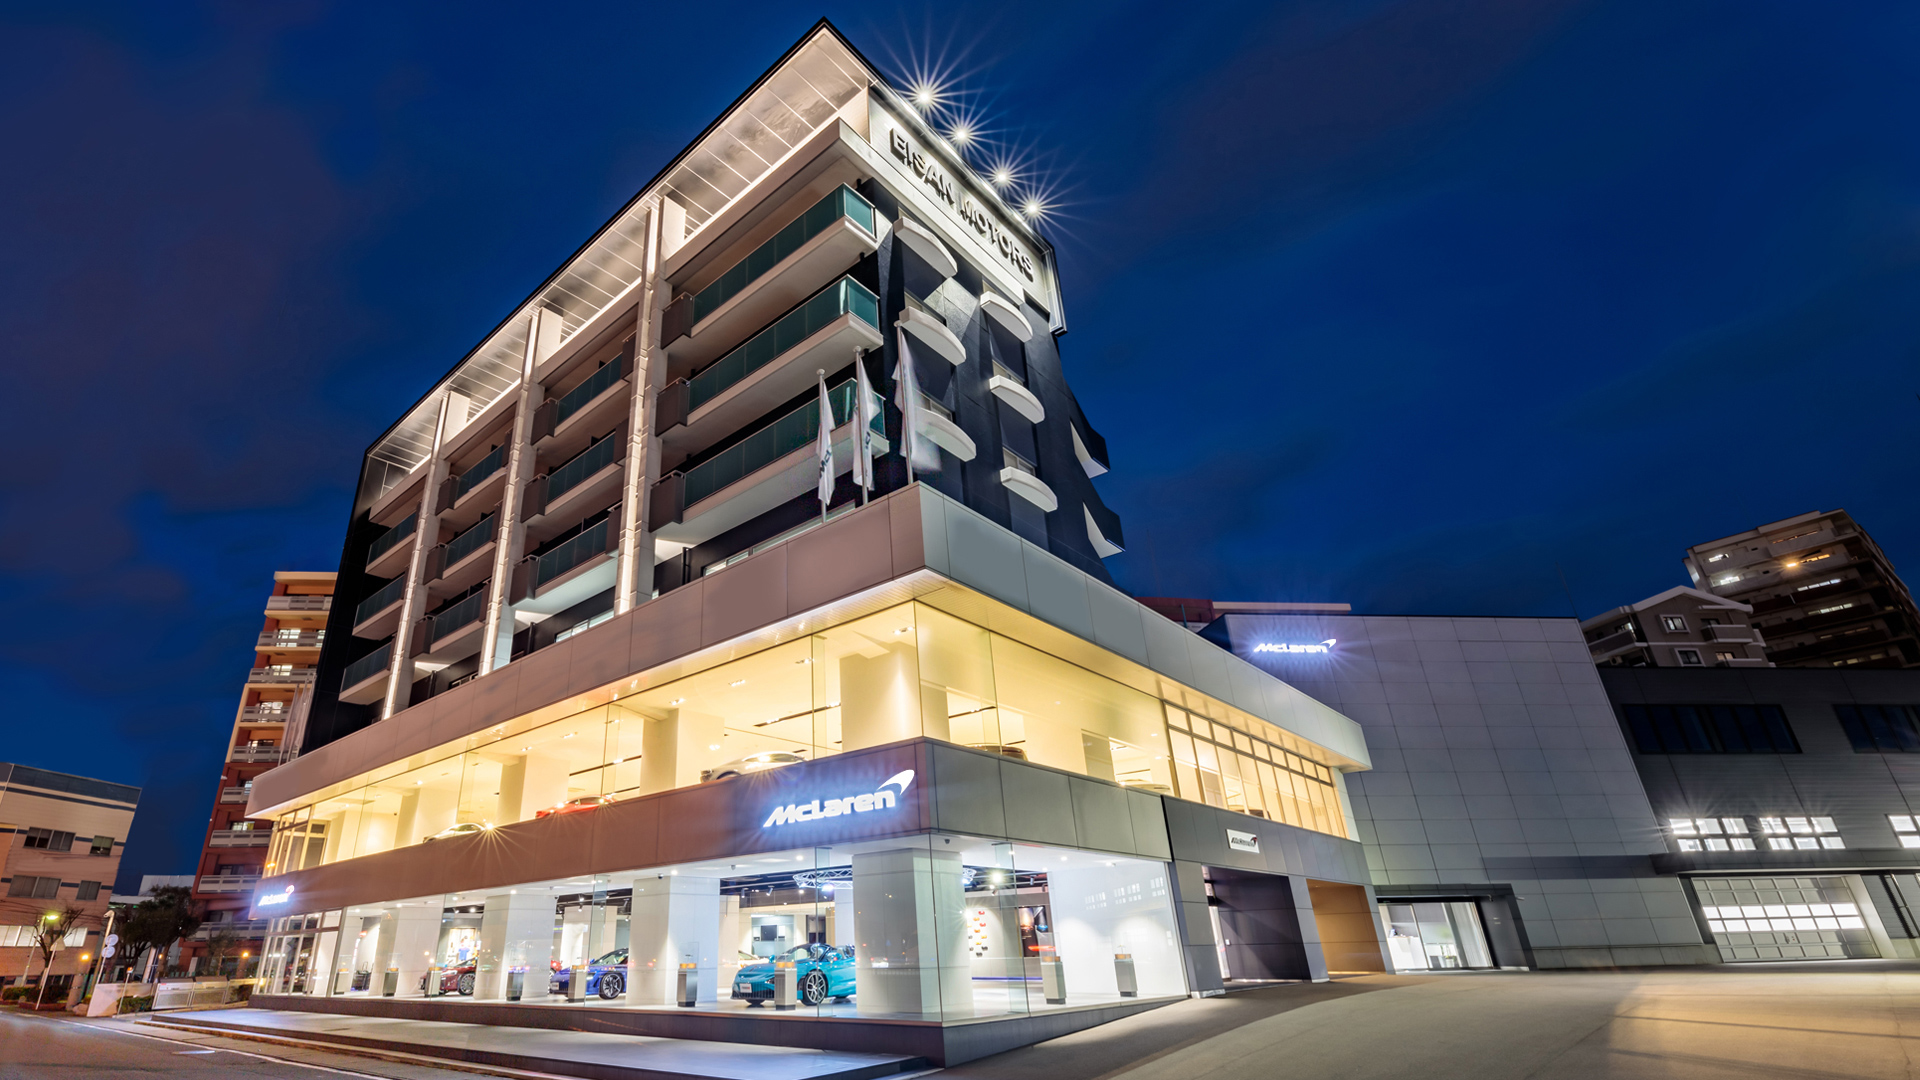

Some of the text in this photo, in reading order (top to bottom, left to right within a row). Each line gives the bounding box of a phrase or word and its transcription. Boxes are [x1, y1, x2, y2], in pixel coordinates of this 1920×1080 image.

[890, 128, 1034, 283] EISAN MOTORS
[1254, 643, 1328, 653] McLaren
[763, 789, 896, 828] McLaren
